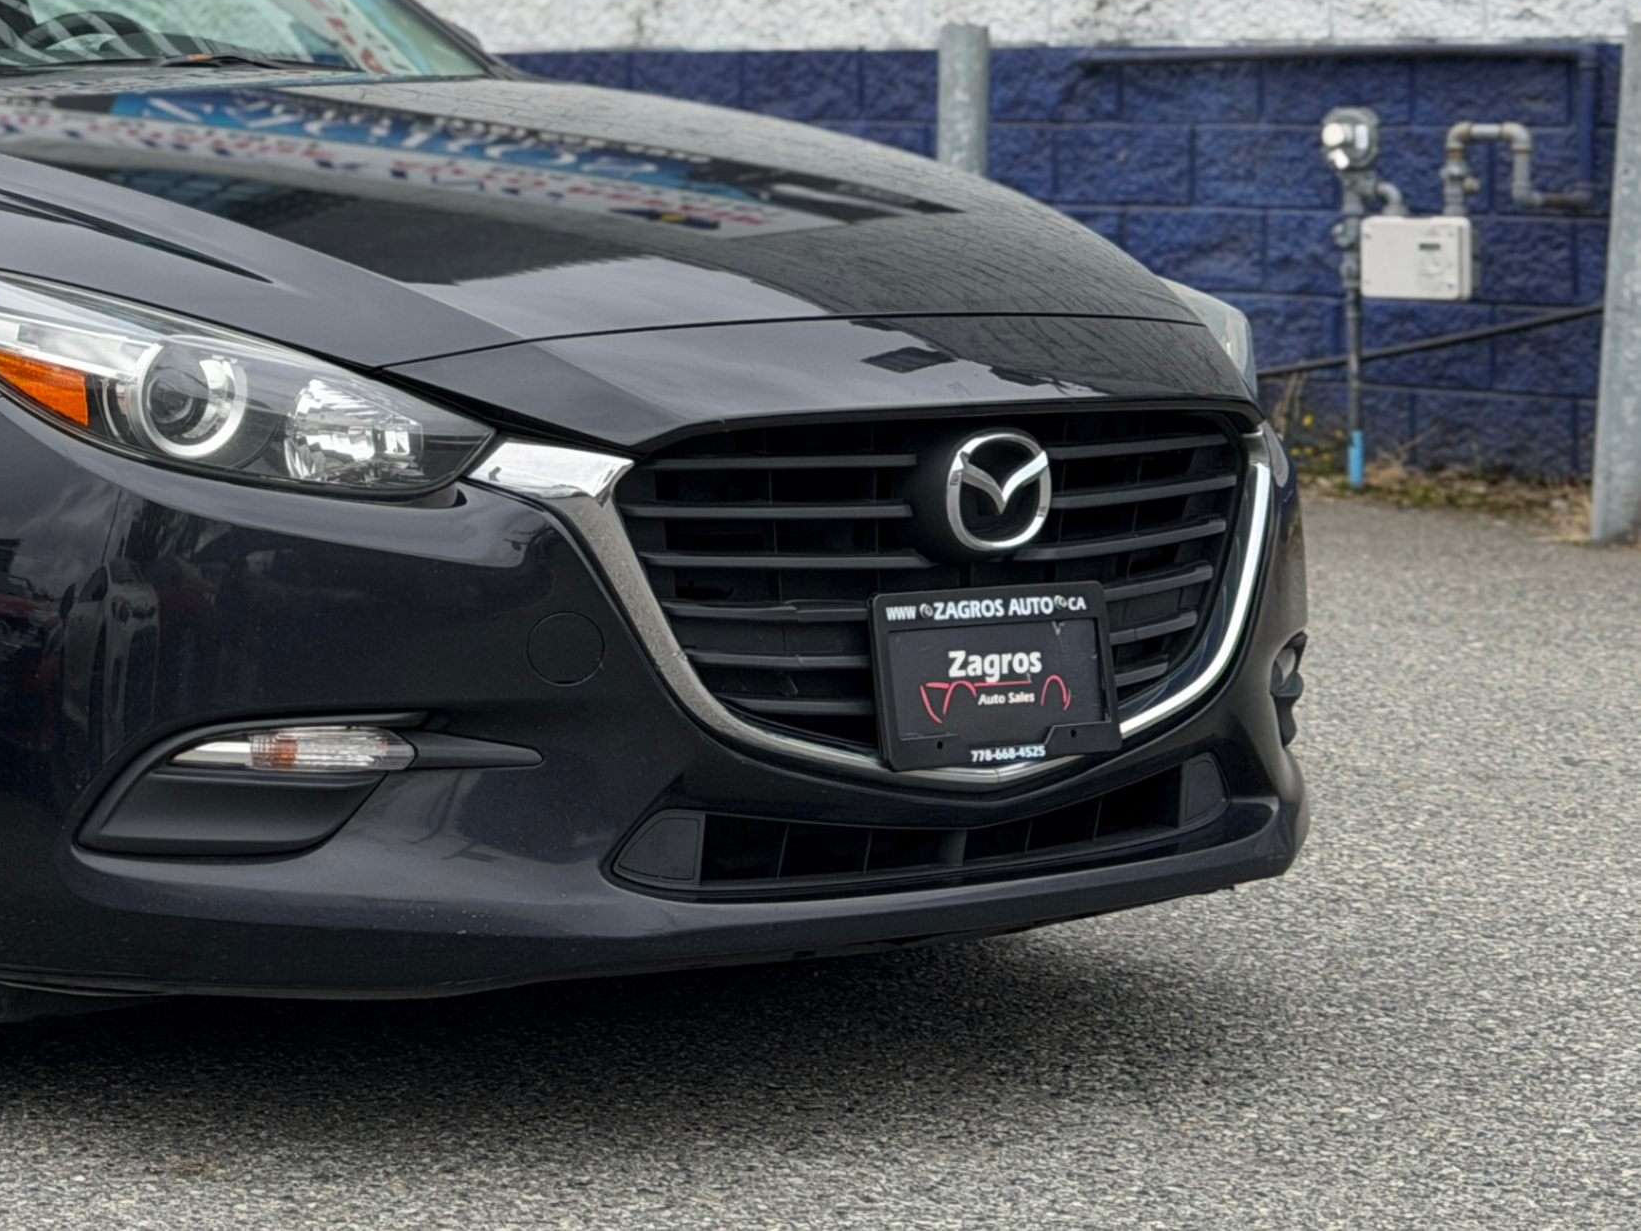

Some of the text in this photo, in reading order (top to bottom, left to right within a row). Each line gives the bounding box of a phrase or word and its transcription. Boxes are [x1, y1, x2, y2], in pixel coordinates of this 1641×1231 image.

[885, 596, 1087, 621] WWW ZAGROS AUTO CA
[947, 650, 1043, 683] Zagros
[977, 691, 1036, 706] Auto Sales
[970, 745, 1047, 763] 778-668-4525
